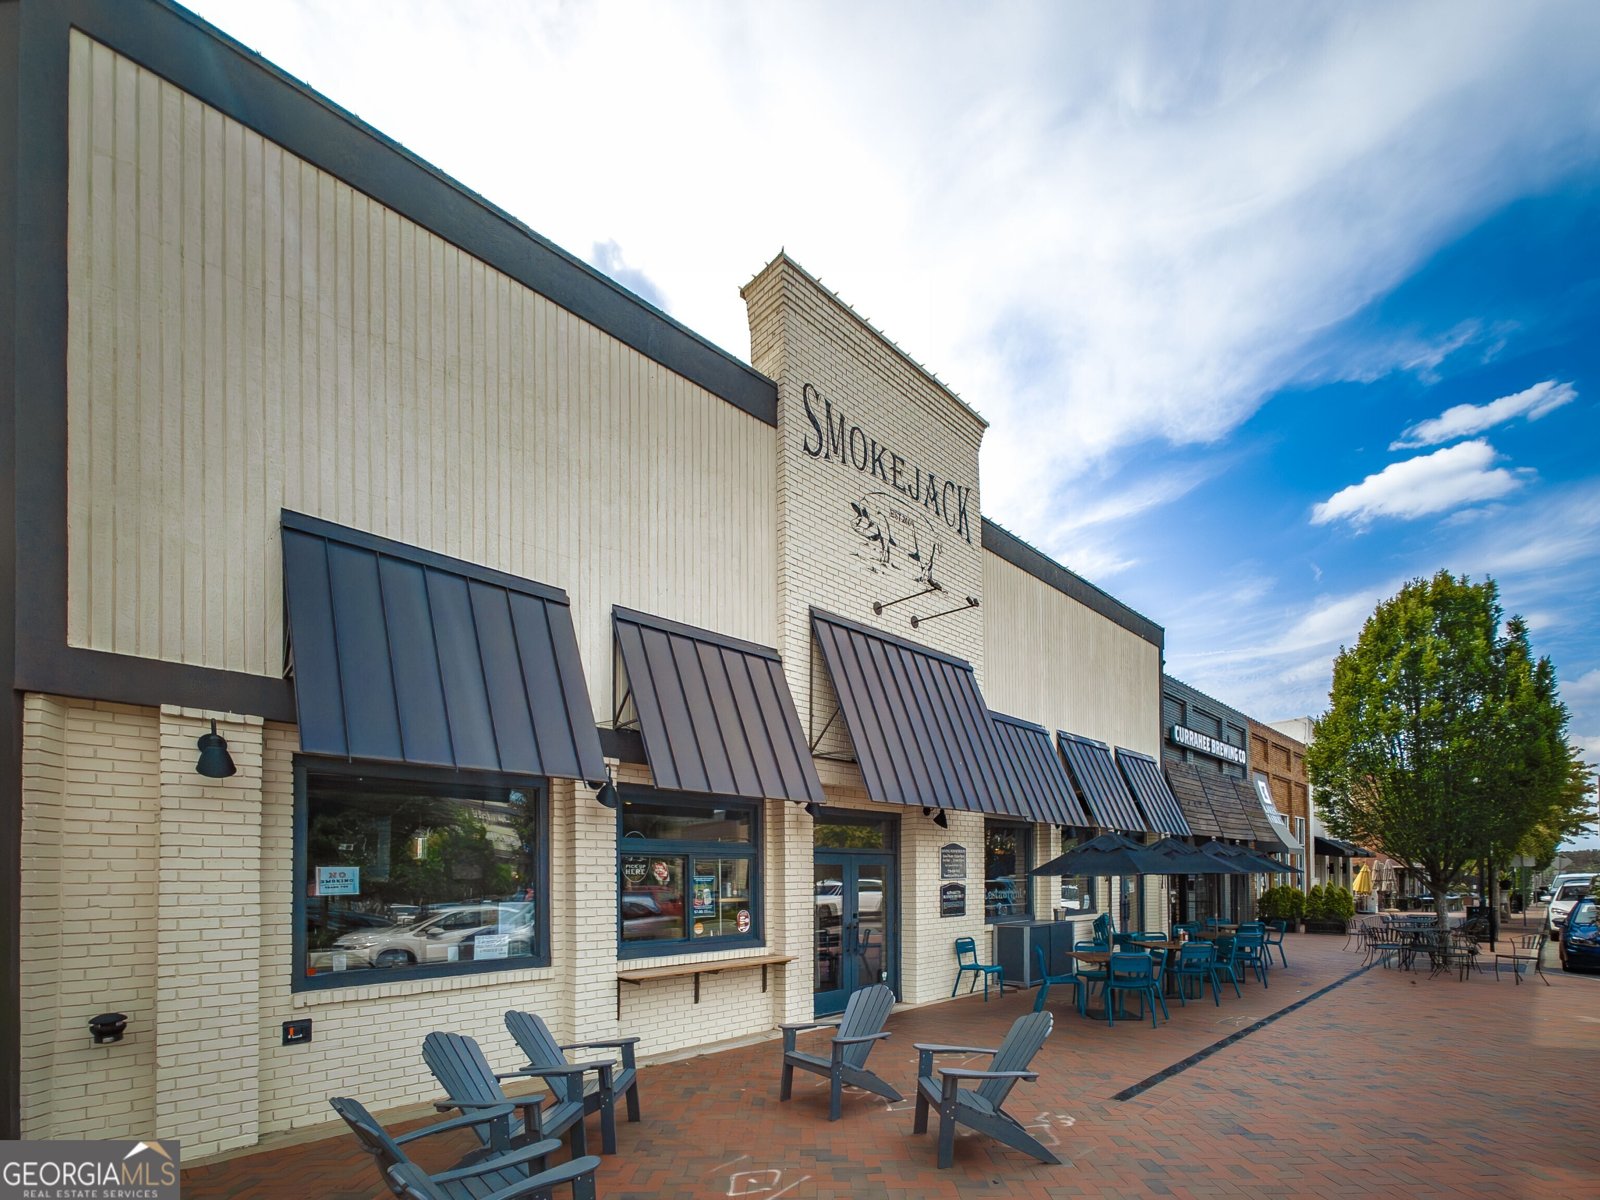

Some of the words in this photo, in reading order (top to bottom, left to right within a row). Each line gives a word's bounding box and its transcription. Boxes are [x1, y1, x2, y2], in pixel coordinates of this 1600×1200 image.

[1175, 725, 1211, 752] CURRAHEE
[1211, 739, 1239, 762] BREWING
[1238, 749, 1246, 764] CO
